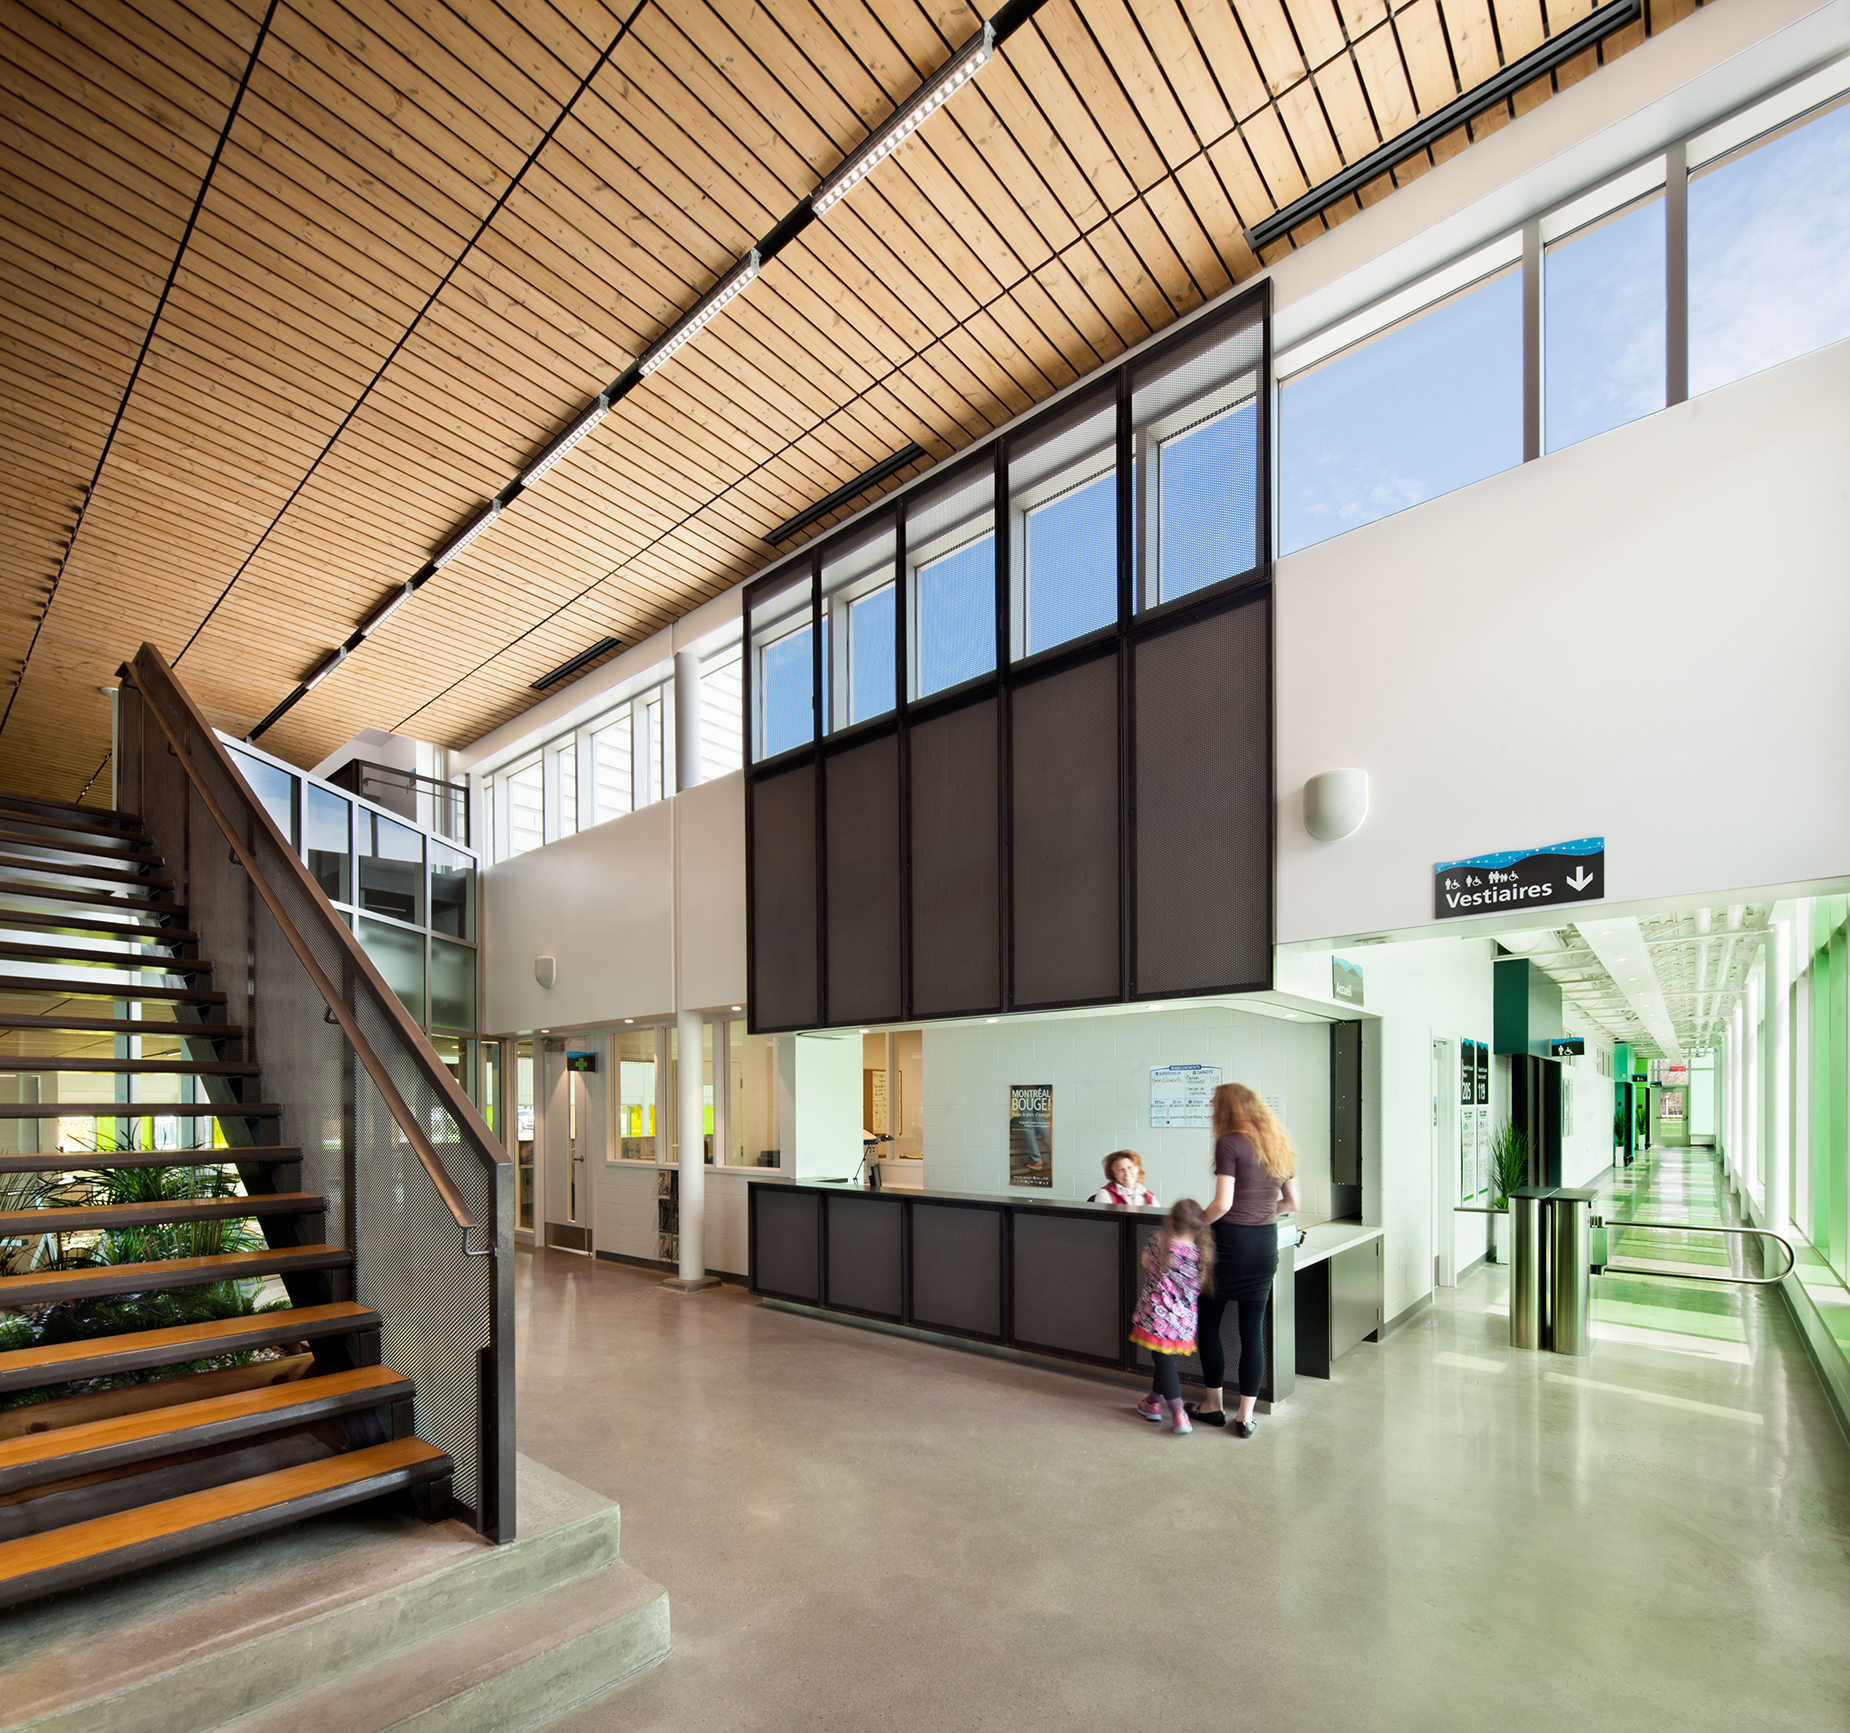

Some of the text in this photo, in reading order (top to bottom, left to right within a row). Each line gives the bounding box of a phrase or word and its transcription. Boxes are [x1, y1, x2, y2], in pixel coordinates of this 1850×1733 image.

[1446, 882, 1552, 909] Vestiaires
[1336, 981, 1352, 997] Accueil
[1210, 1075, 1219, 1083] 119
[1012, 1088, 1051, 1098] MONTRÉAL
[1462, 1082, 1471, 1100] 205
[1012, 1098, 1051, 1111] BOUGE!
